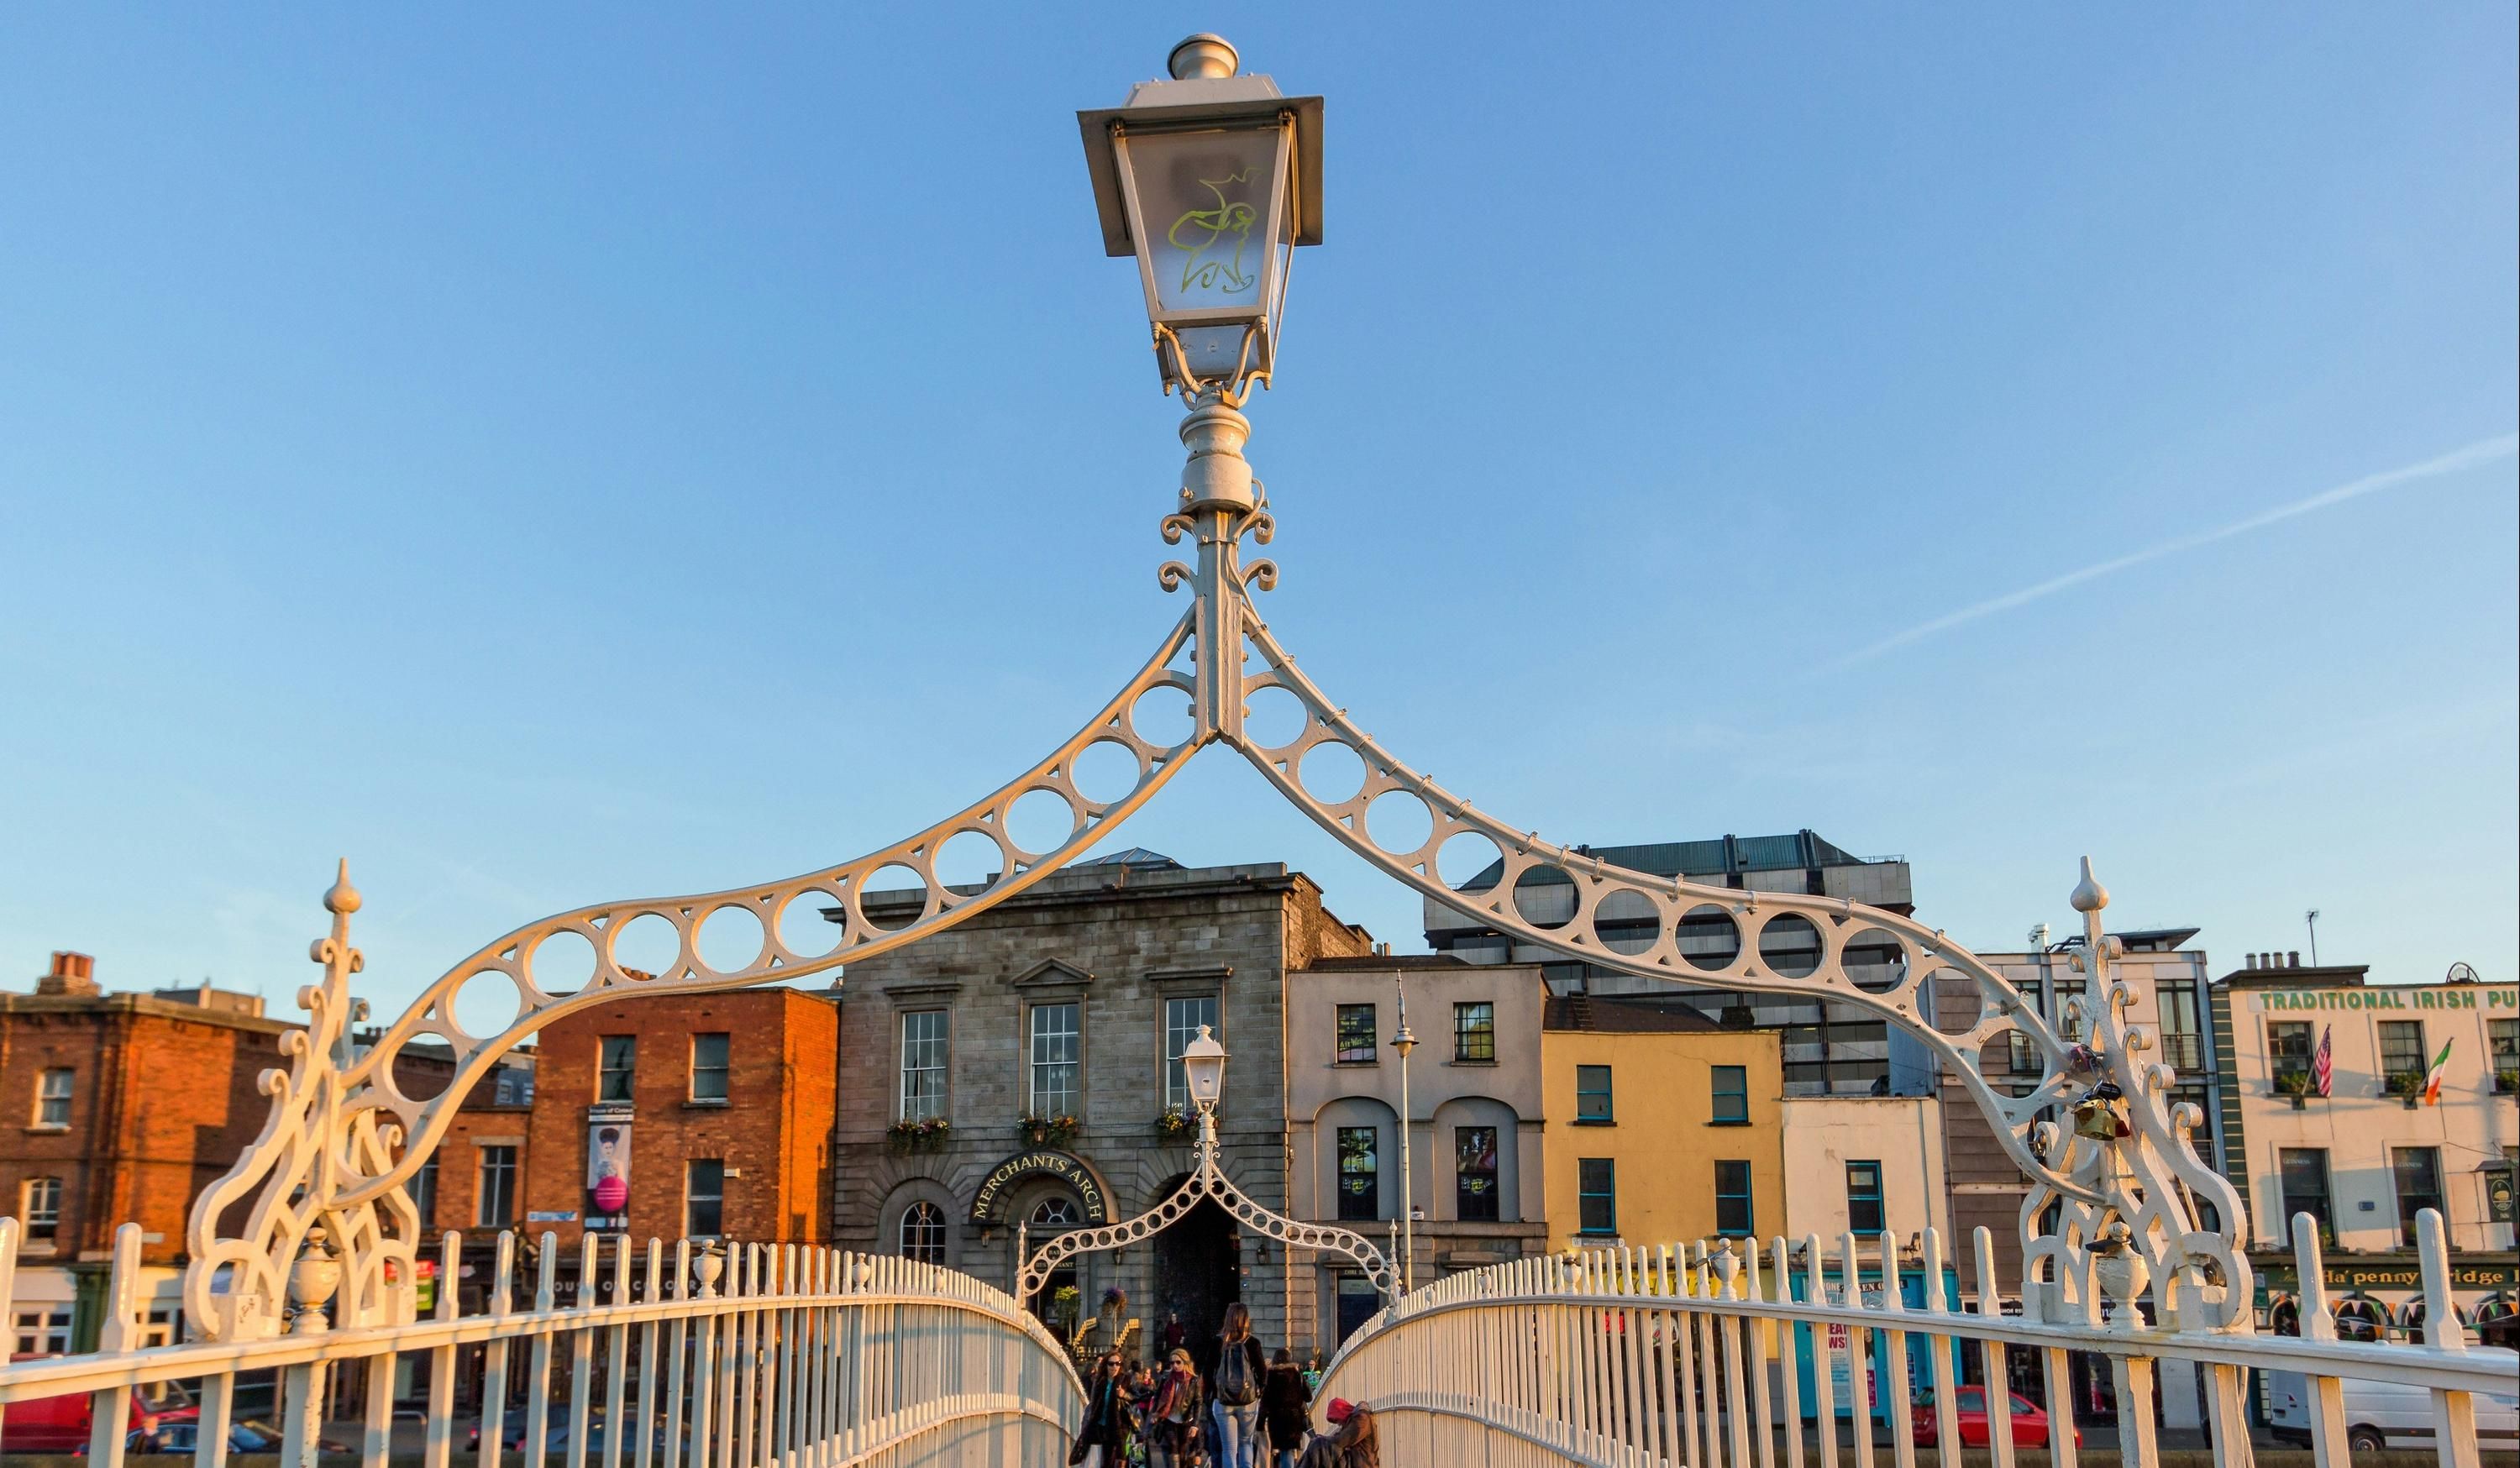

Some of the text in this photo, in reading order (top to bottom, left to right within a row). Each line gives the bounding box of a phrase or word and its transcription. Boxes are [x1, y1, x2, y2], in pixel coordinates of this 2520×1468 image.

[2260, 990, 2518, 1009] TRADITIONAL IRISH PU
[1068, 1170, 1101, 1219] ARCH
